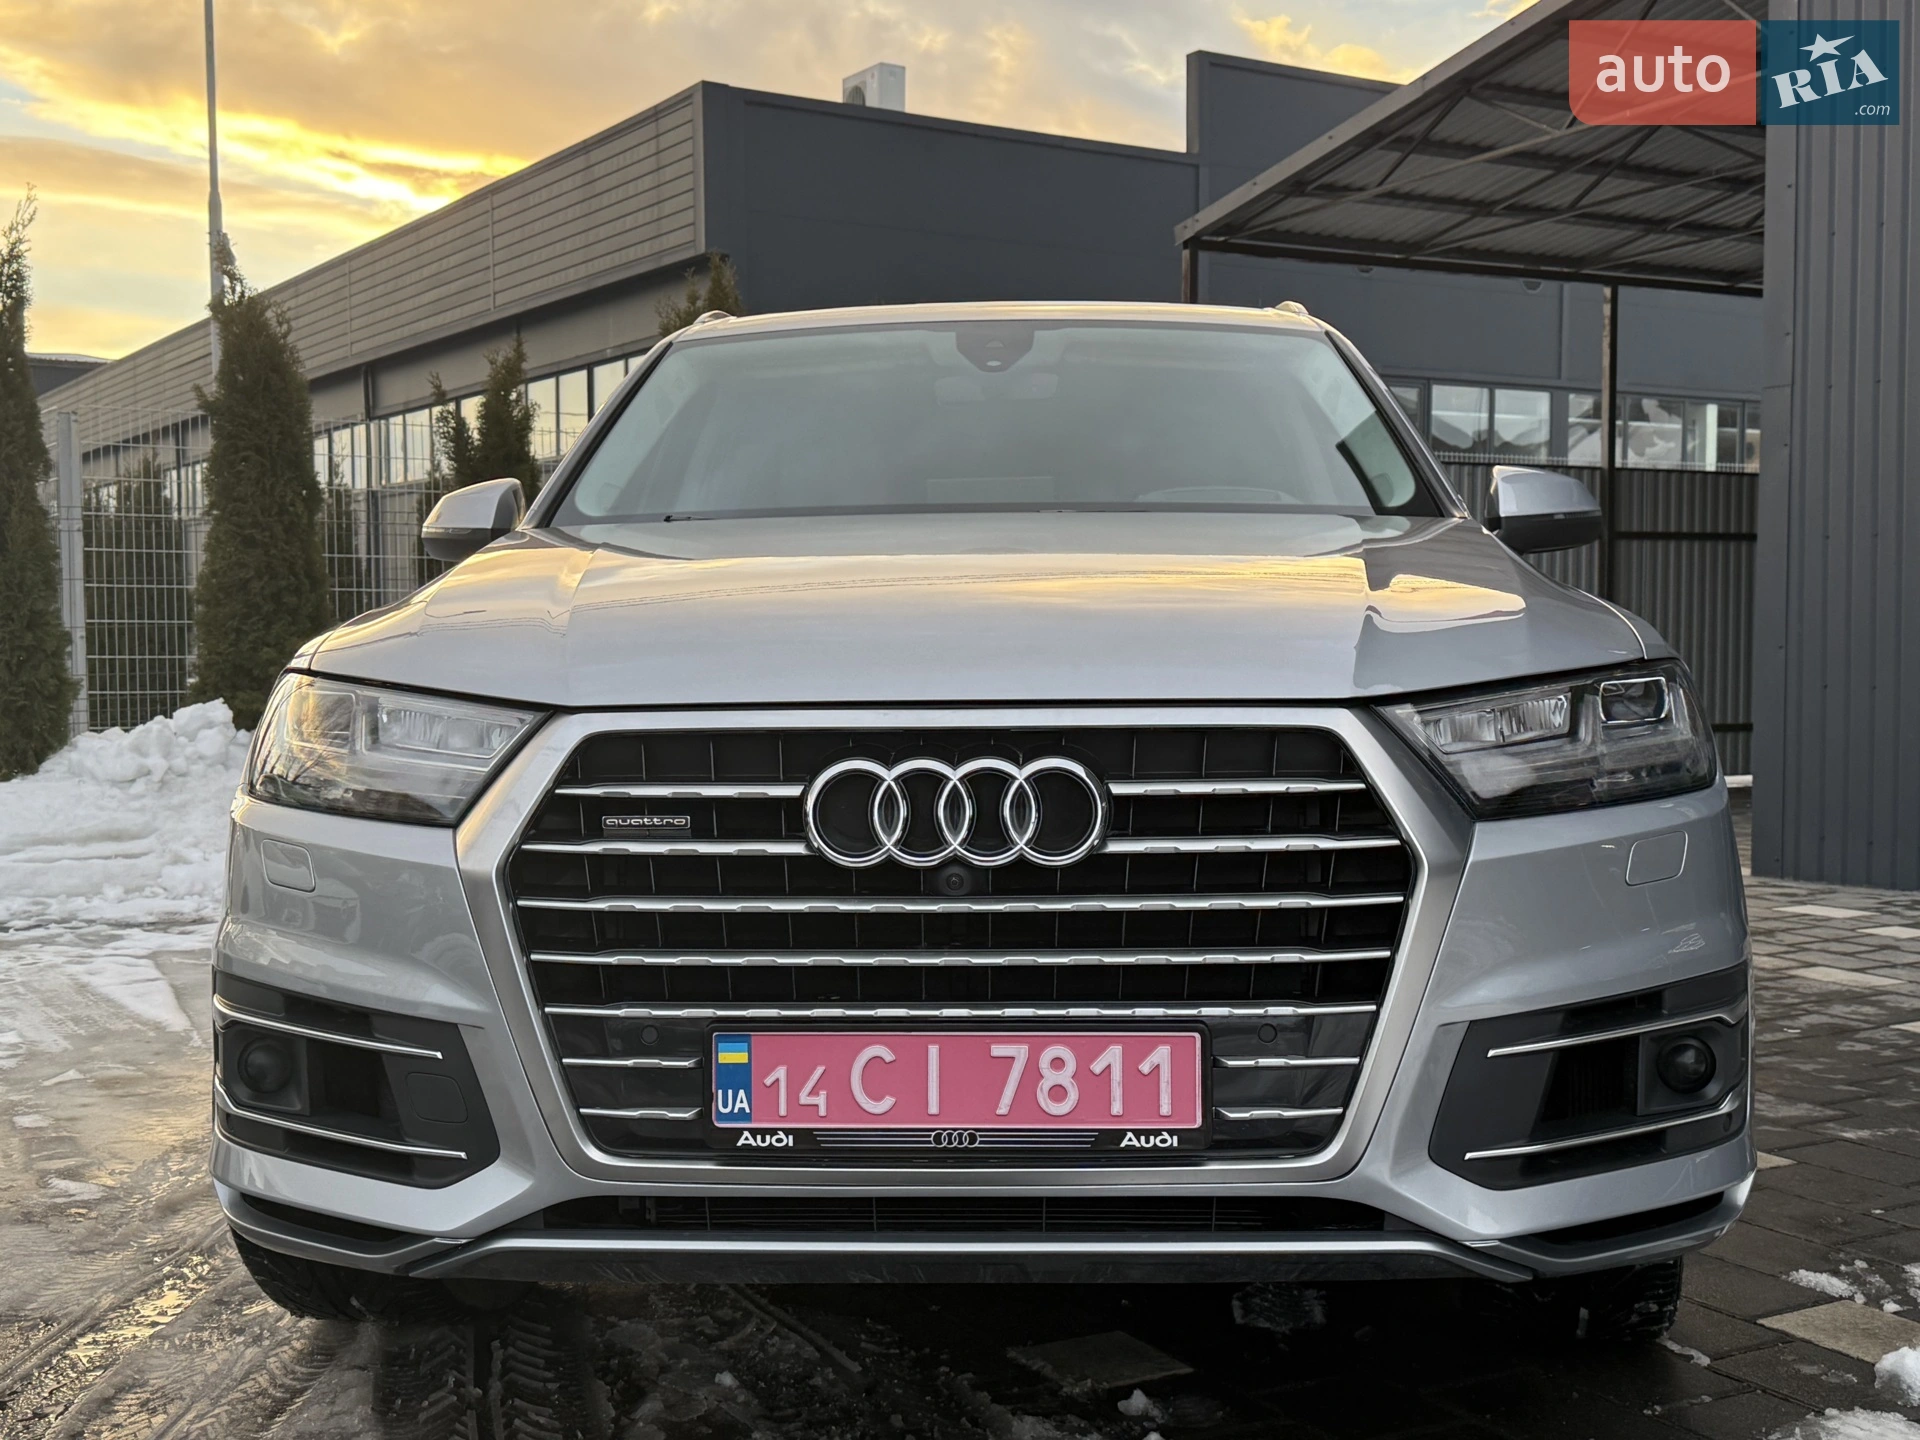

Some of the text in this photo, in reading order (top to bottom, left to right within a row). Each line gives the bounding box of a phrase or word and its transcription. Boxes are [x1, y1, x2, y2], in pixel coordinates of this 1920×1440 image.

[606, 817, 686, 827] quattro
[763, 1065, 828, 1117] 14
[990, 1045, 1173, 1117] 7811
[717, 1088, 751, 1114] UA
[736, 1130, 794, 1147] Audi
[1119, 1130, 1179, 1147] Audi
